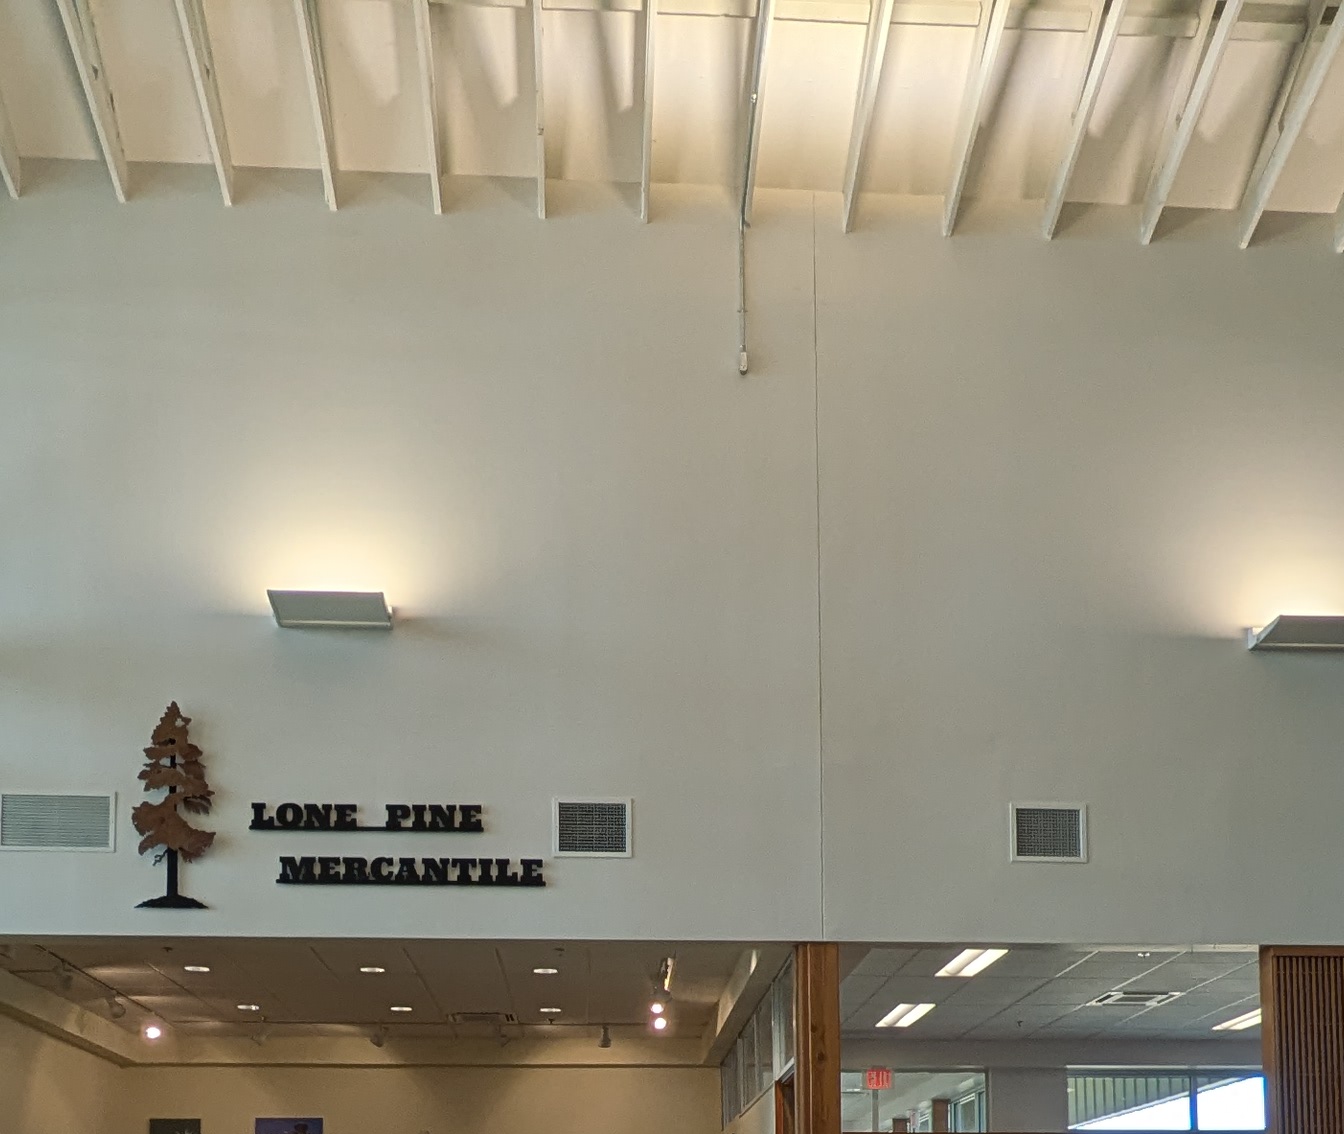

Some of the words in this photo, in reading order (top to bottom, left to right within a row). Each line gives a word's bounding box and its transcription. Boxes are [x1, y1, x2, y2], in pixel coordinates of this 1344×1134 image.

[249, 802, 358, 829] LONE
[385, 803, 485, 830] PINE
[277, 856, 546, 886] MERCANTILE
